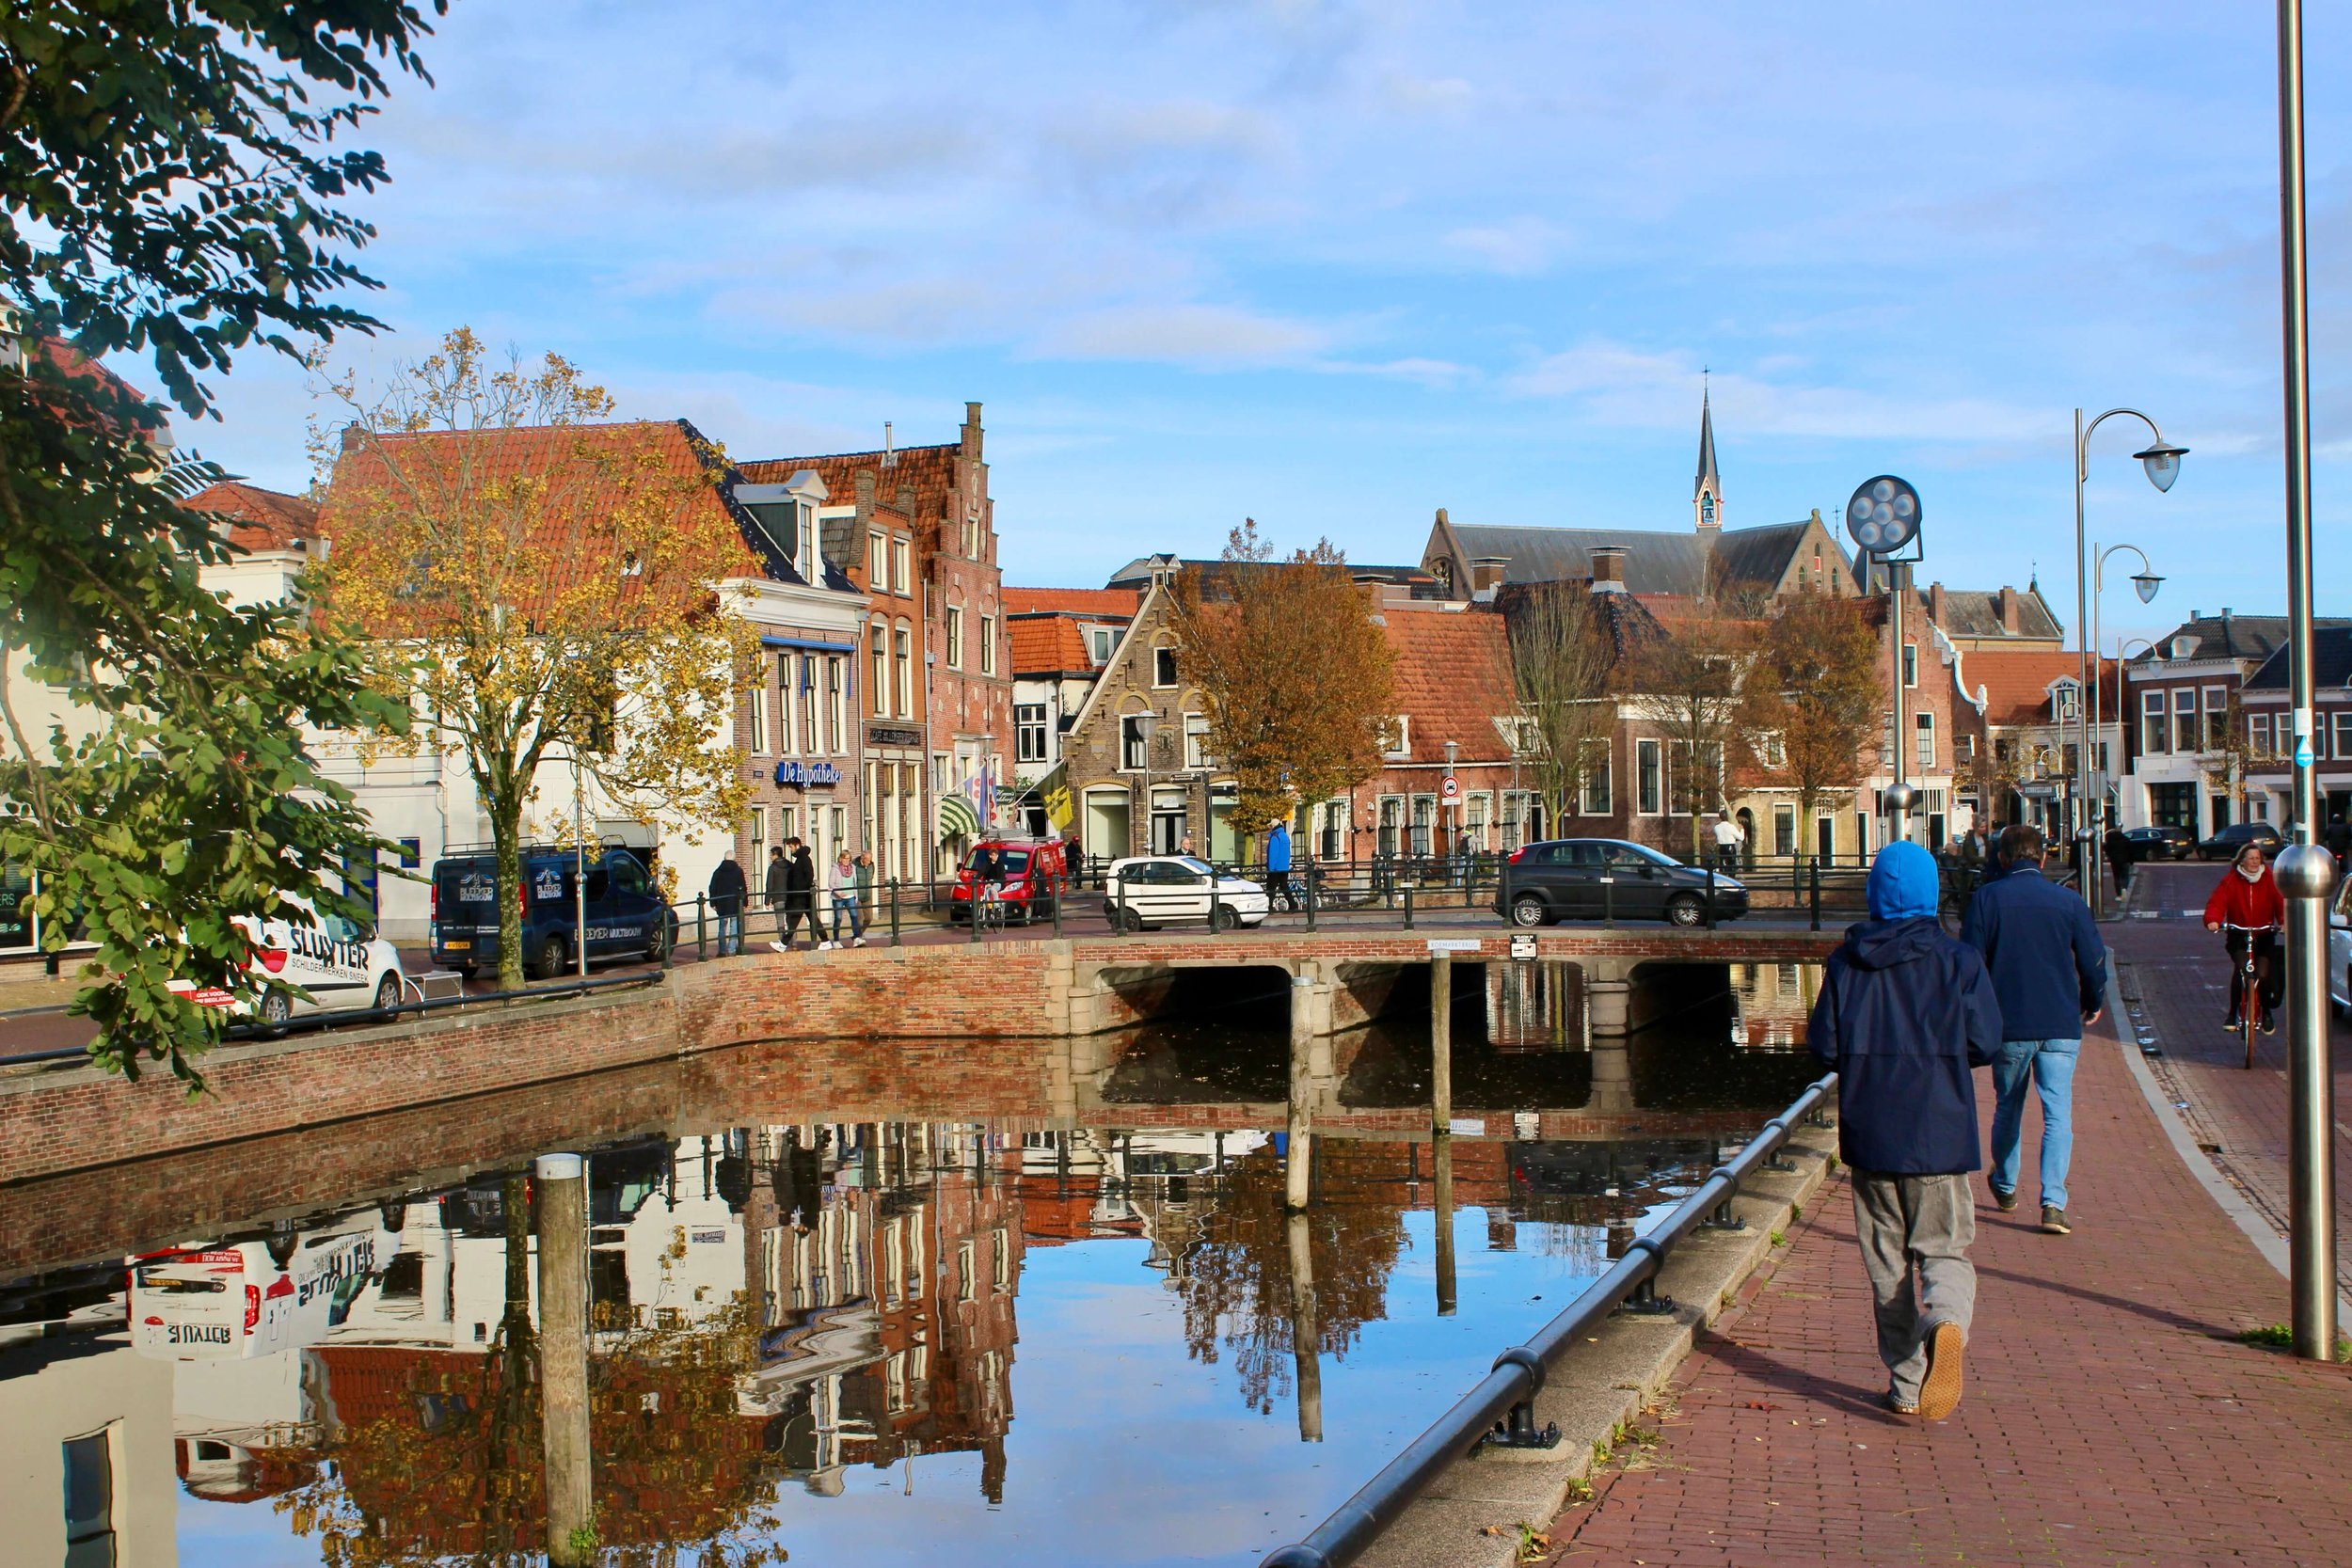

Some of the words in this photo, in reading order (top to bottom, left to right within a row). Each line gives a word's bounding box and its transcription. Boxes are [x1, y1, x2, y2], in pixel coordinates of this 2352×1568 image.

[783, 762, 796, 783] De
[796, 762, 844, 787] Hypotheker
[292, 958, 348, 979] SCHILDERWERKEN
[349, 971, 369, 983] SNEEK
